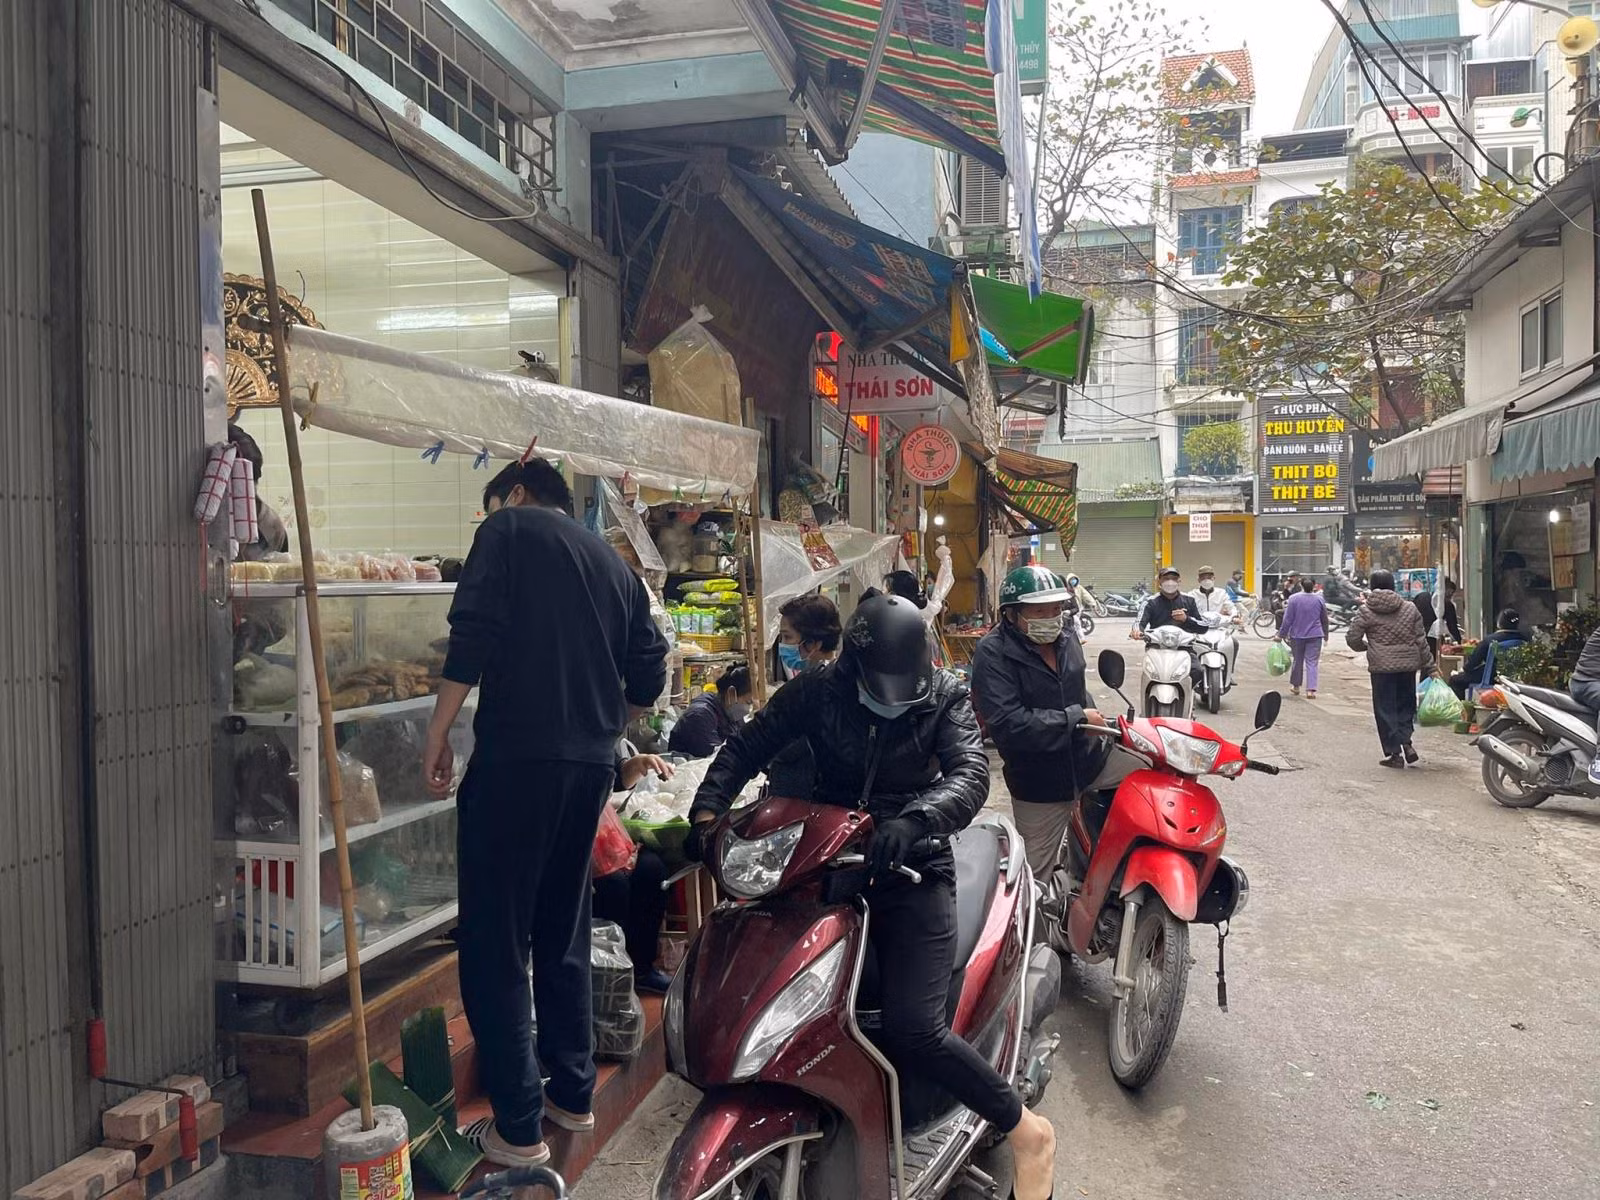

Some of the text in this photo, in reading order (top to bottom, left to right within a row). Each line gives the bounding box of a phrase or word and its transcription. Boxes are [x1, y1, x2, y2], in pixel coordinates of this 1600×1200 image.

[845, 376, 889, 399] THÁI
[895, 375, 933, 398] SƠN
[1273, 403, 1303, 416] THỰC
[1264, 413, 1345, 436] THU HUYỀN
[1271, 458, 1337, 483] THỊT BÒ
[1271, 479, 1336, 504] THỊT BÊ
[796, 1044, 836, 1077] HONDA
